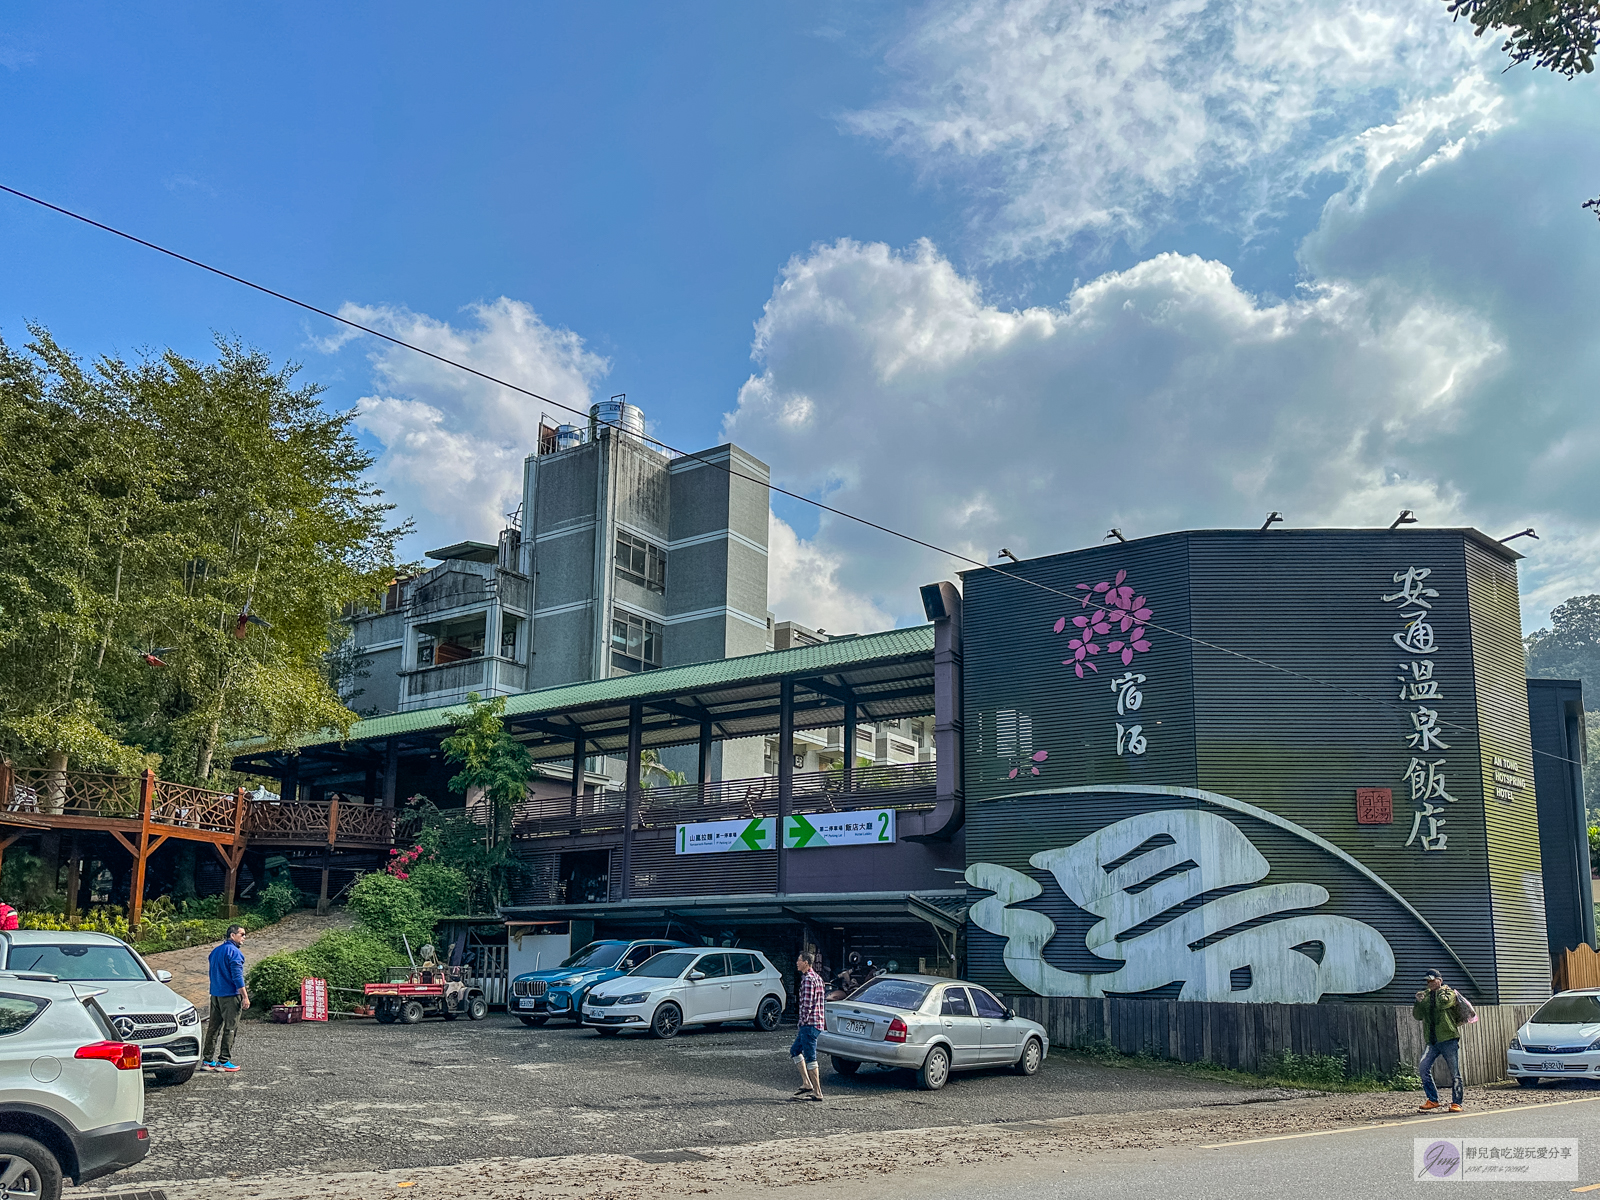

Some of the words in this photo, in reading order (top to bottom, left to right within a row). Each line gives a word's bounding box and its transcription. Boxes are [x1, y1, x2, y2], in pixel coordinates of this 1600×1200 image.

[1381, 566, 1458, 851] 安通溫泉飯店
[1493, 756, 1503, 767] AN
[1503, 759, 1519, 771] TONG
[1494, 770, 1526, 788] HOTSPRING
[1496, 787, 1514, 800] HOTEL
[845, 822, 873, 832] 飯店大廳
[878, 812, 890, 842] 2
[679, 826, 686, 852] 1
